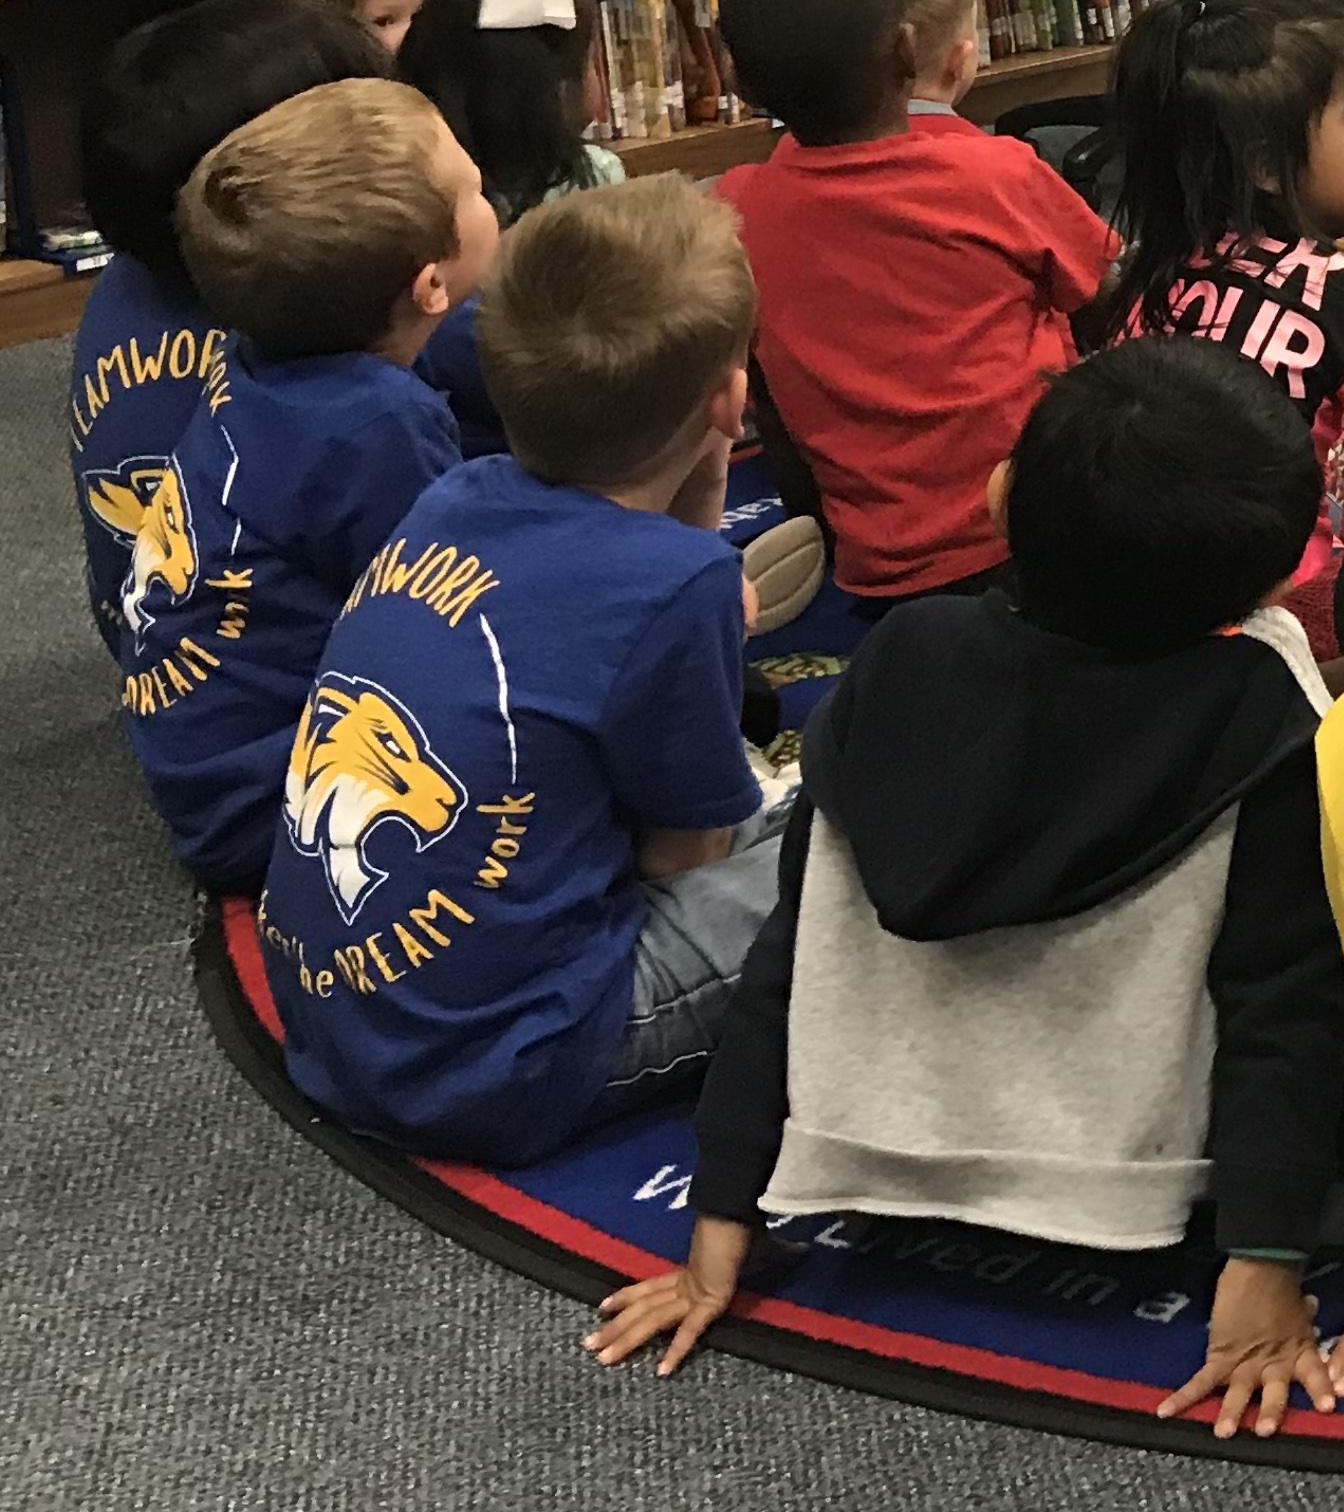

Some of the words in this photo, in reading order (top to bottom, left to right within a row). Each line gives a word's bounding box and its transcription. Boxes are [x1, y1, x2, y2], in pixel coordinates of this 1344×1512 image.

[334, 889, 475, 996] DREAM
[474, 791, 536, 888] work
[1132, 1290, 1193, 1324] a
